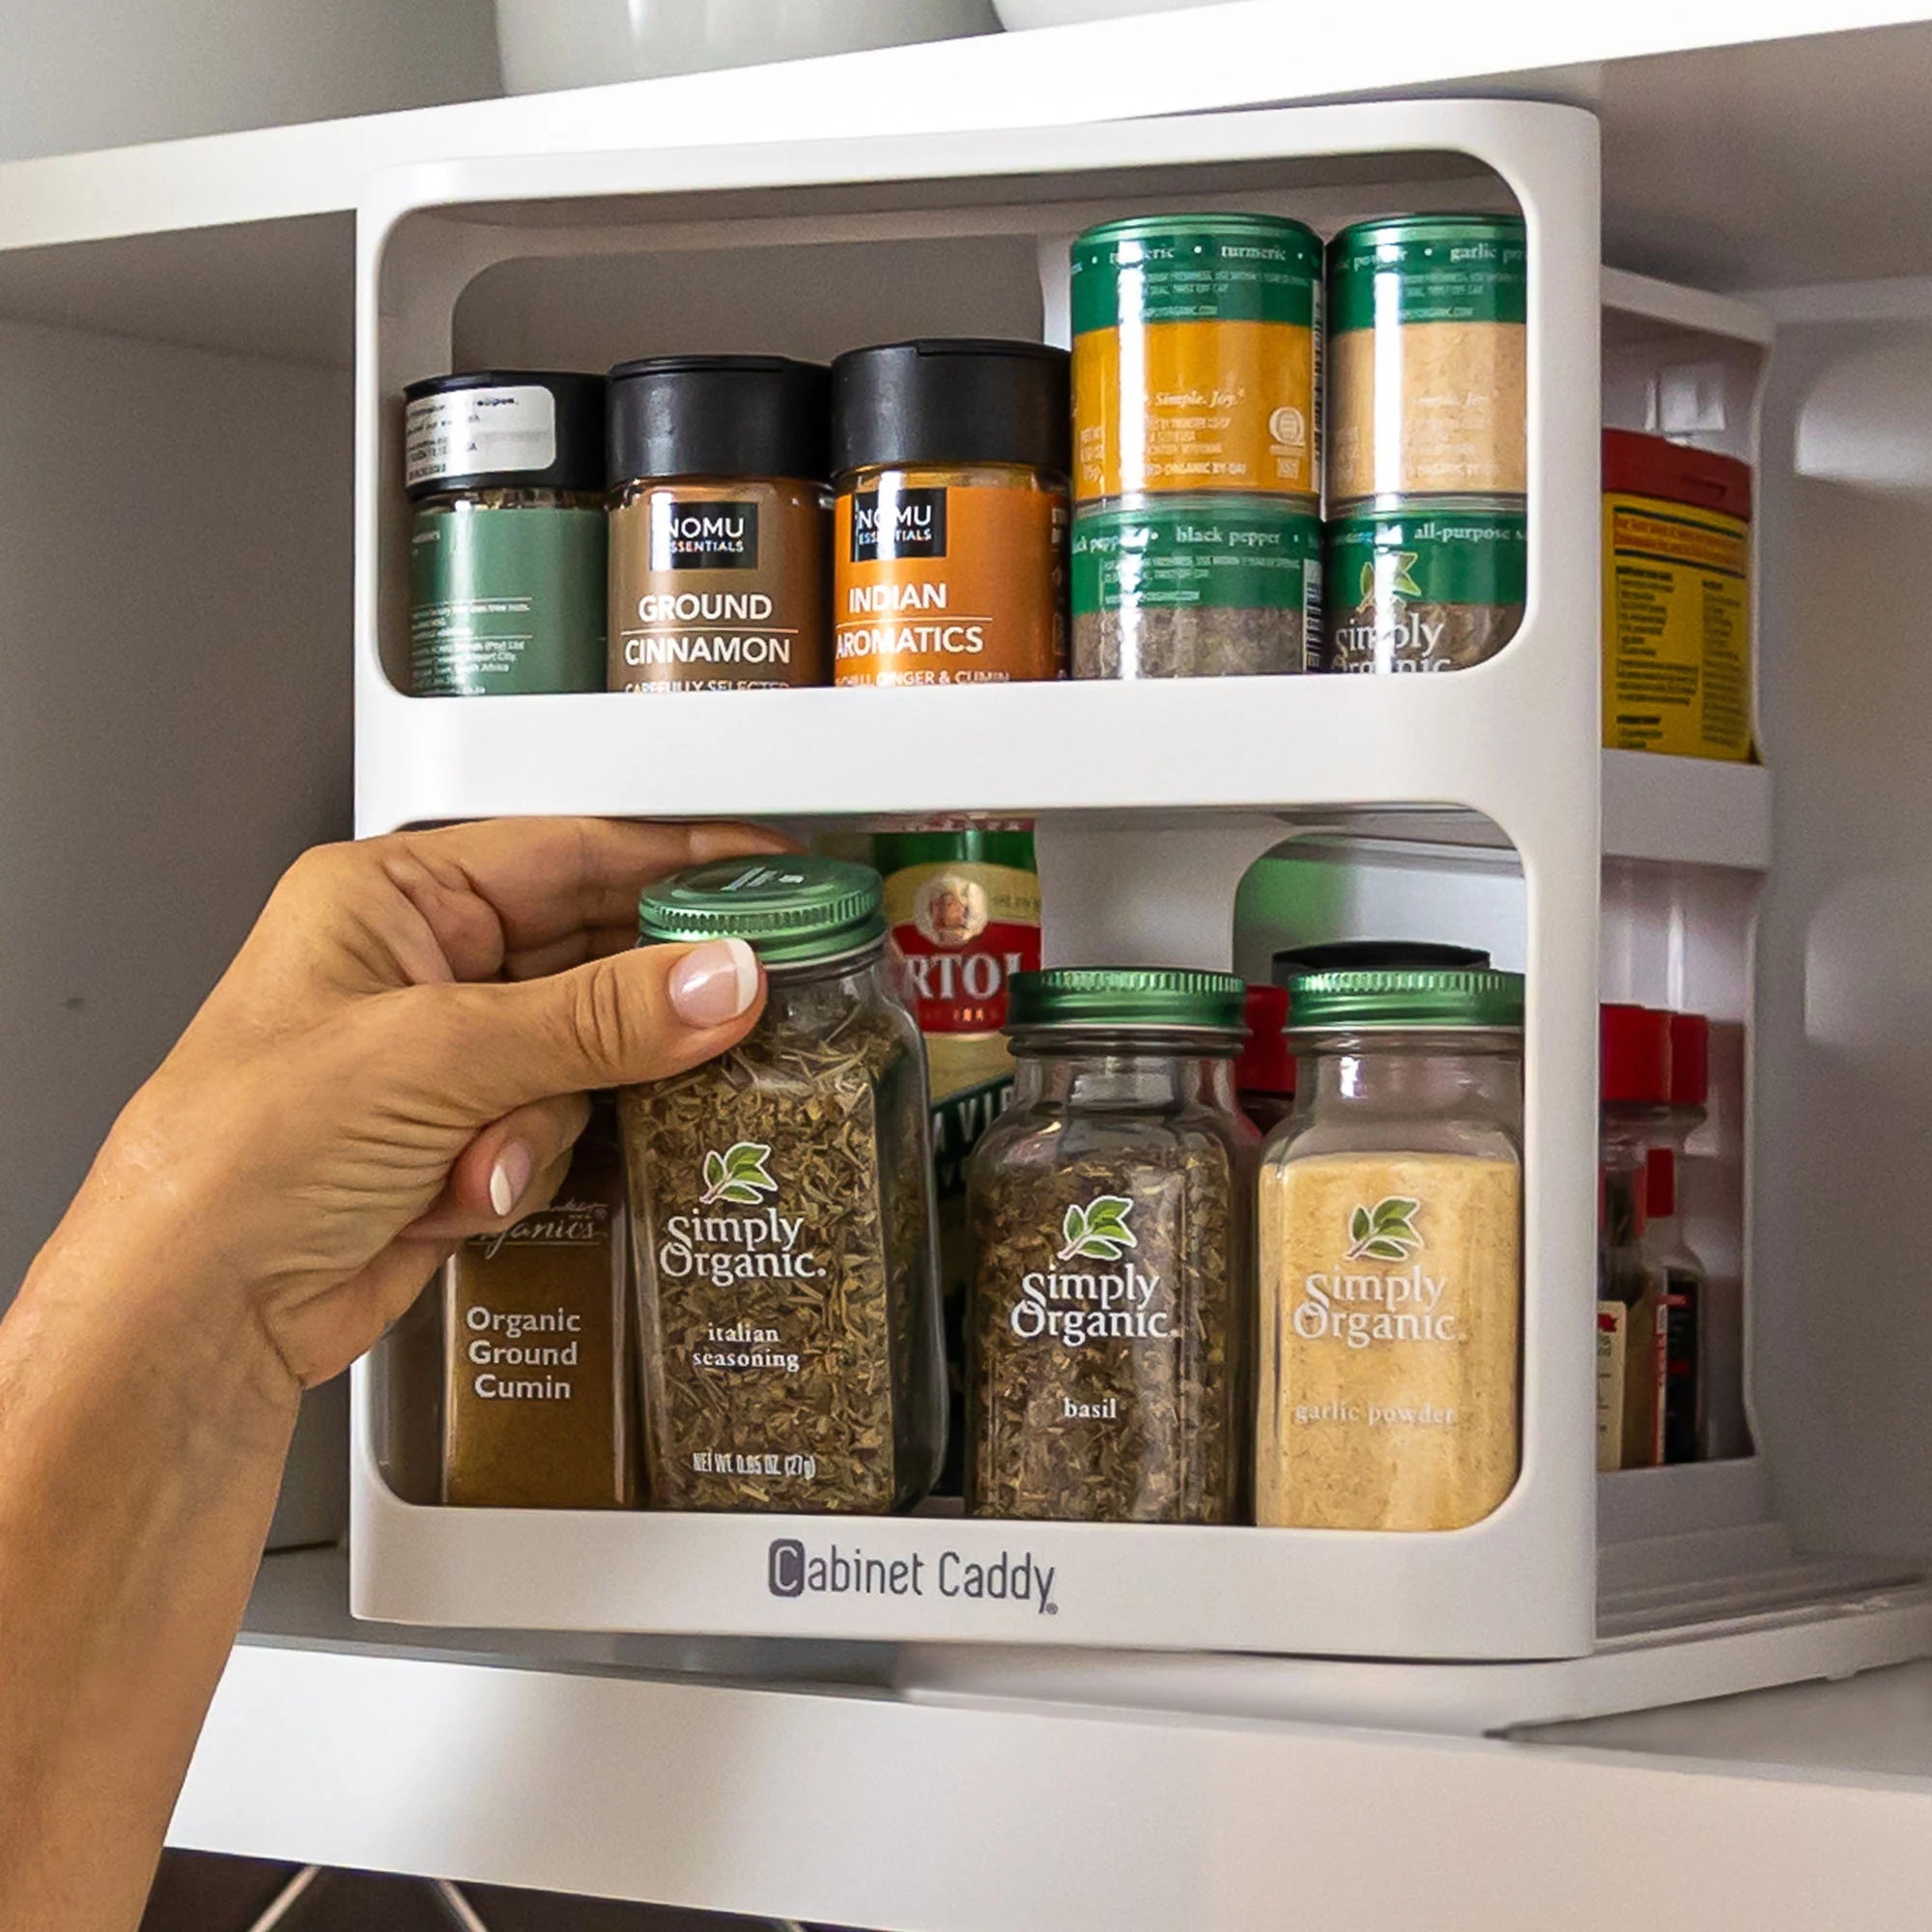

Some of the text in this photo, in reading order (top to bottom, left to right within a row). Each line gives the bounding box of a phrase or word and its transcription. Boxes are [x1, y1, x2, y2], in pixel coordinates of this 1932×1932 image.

[1221, 244, 1286, 261] turmeric
[1450, 243, 1496, 262] garlic
[1177, 526, 1223, 543] black
[1229, 531, 1282, 547] pepper
[1414, 523, 1511, 542] all-purpose
[670, 540, 745, 554] SSENTIALS
[638, 593, 773, 623] GROUND
[848, 582, 948, 613] INDIAN
[624, 637, 791, 667] CINNAMON
[836, 626, 983, 659] AROMATICS
[939, 669, 951, 684] &
[668, 1208, 804, 1254] Simply
[1021, 1263, 1161, 1314] Simply
[1305, 1264, 1447, 1314] Simply
[466, 1307, 582, 1339] Organic
[708, 1321, 781, 1344] italian
[469, 1340, 578, 1366] Ground
[692, 1350, 801, 1373] seasoning
[473, 1375, 571, 1401] Cumin
[1063, 1397, 1118, 1419] basil
[1294, 1400, 1456, 1427] garlic powder
[768, 1539, 924, 1598] Cabinet
